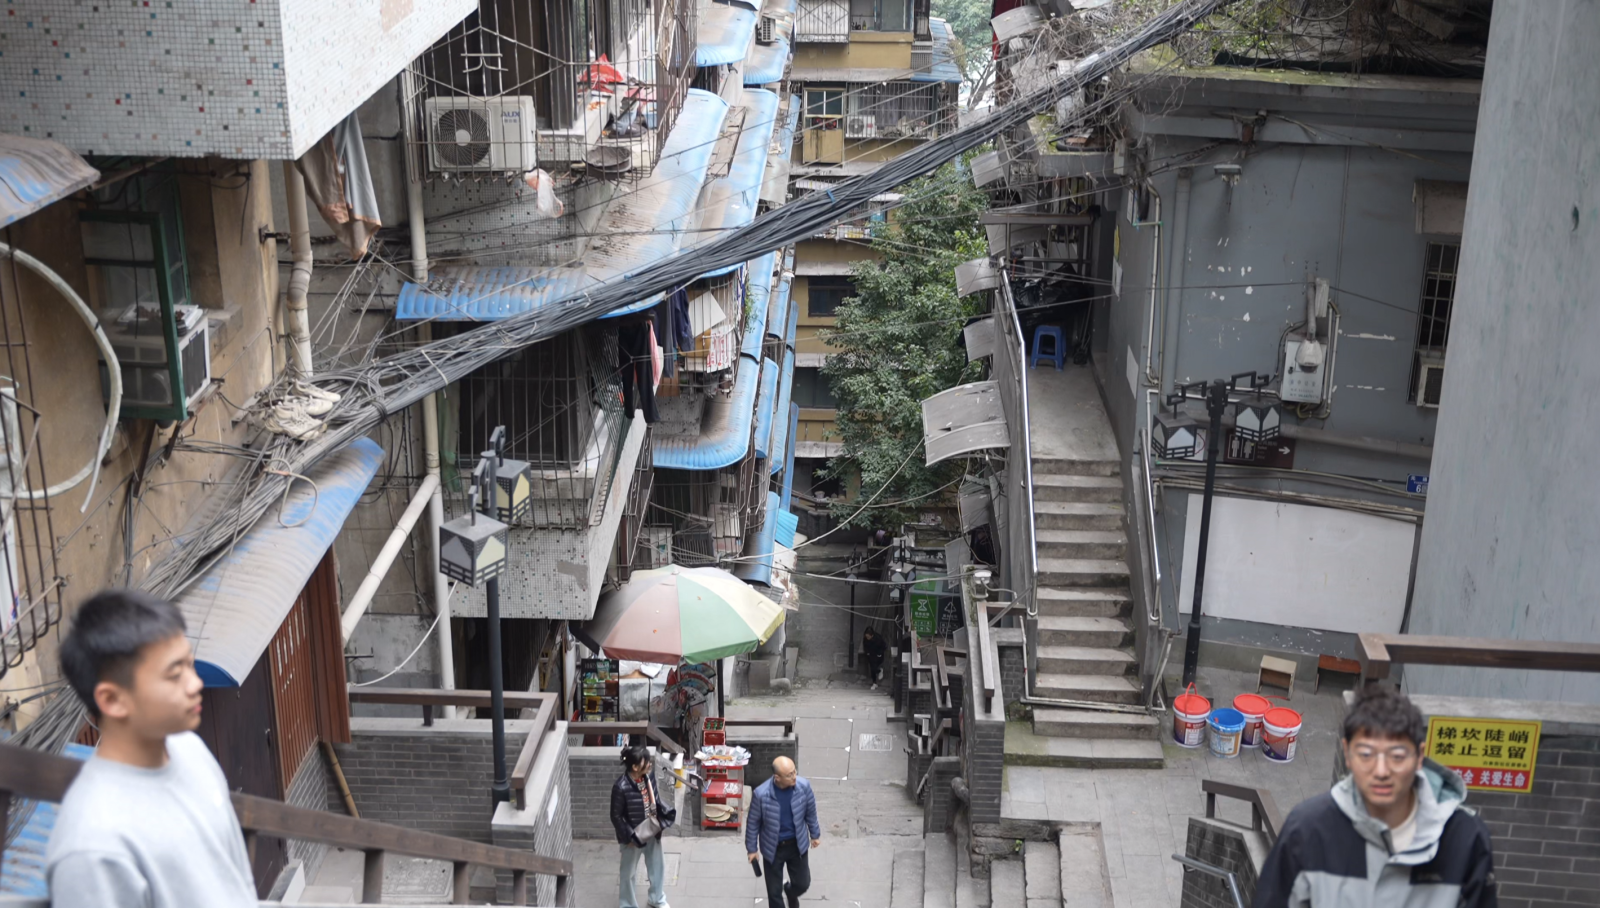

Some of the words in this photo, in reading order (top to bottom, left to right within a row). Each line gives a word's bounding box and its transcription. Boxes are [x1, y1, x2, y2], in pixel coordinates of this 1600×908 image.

[1437, 726, 1529, 744] 梯坎陡峭
[1435, 742, 1527, 760] 禁止逗留
[1479, 770, 1526, 788] 关爱生命
